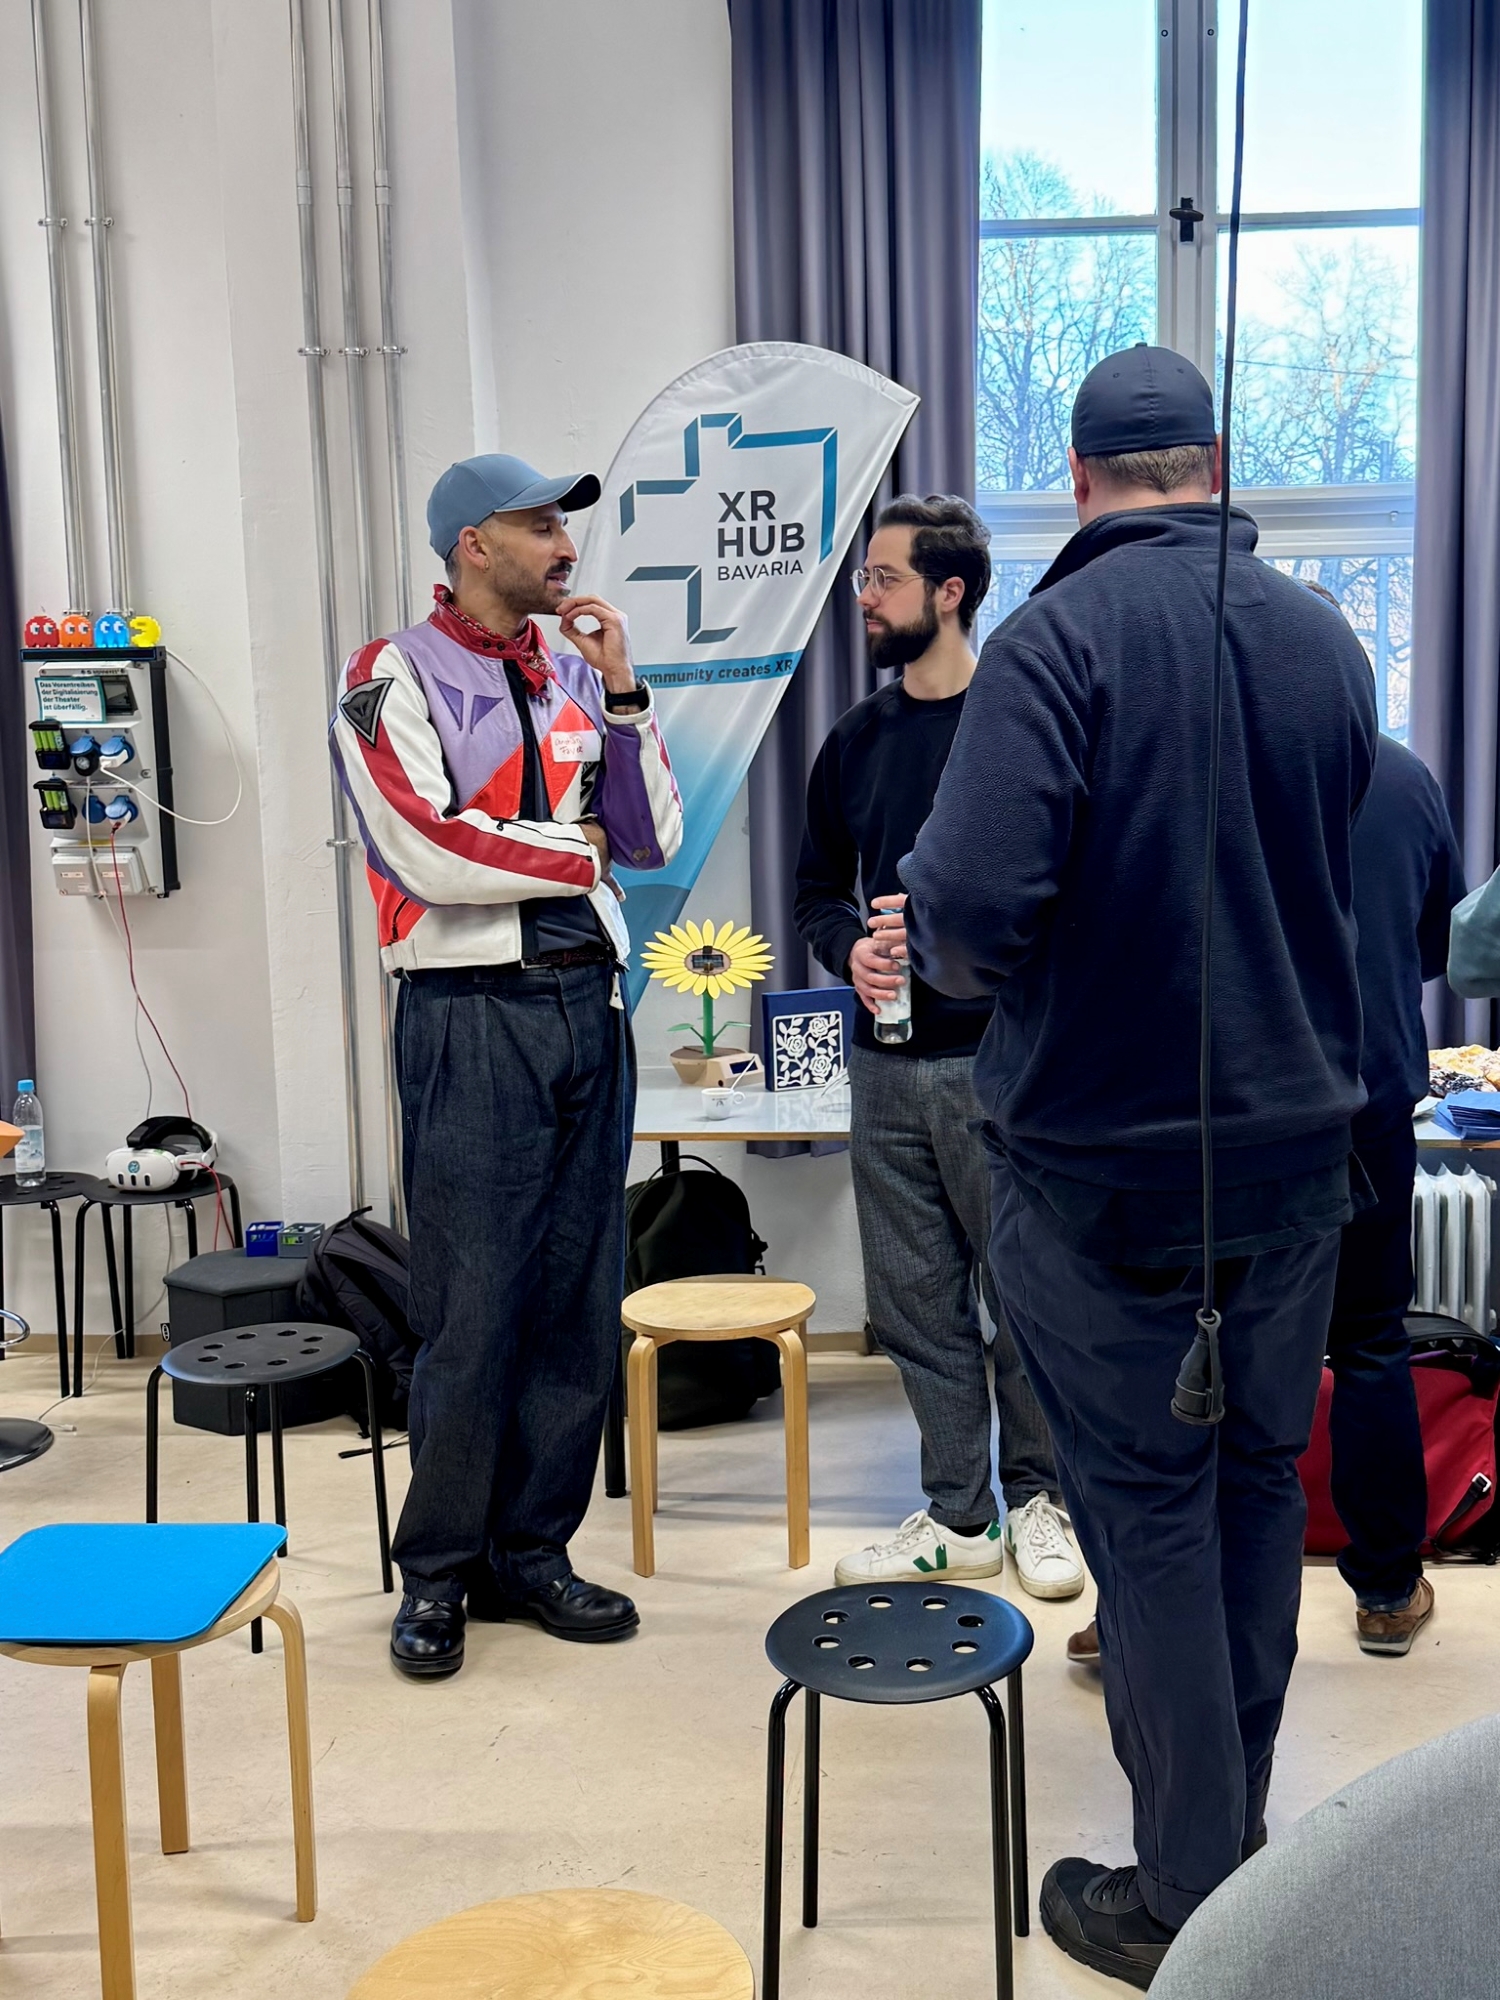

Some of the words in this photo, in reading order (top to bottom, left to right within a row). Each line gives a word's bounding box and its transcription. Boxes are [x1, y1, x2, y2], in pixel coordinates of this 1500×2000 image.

[718, 490, 776, 522] XR
[718, 522, 805, 558] HUB
[718, 559, 804, 581] BAVARIA
[718, 664, 771, 679] creates
[775, 659, 793, 672] XR
[53, 703, 88, 711] überfällig.
